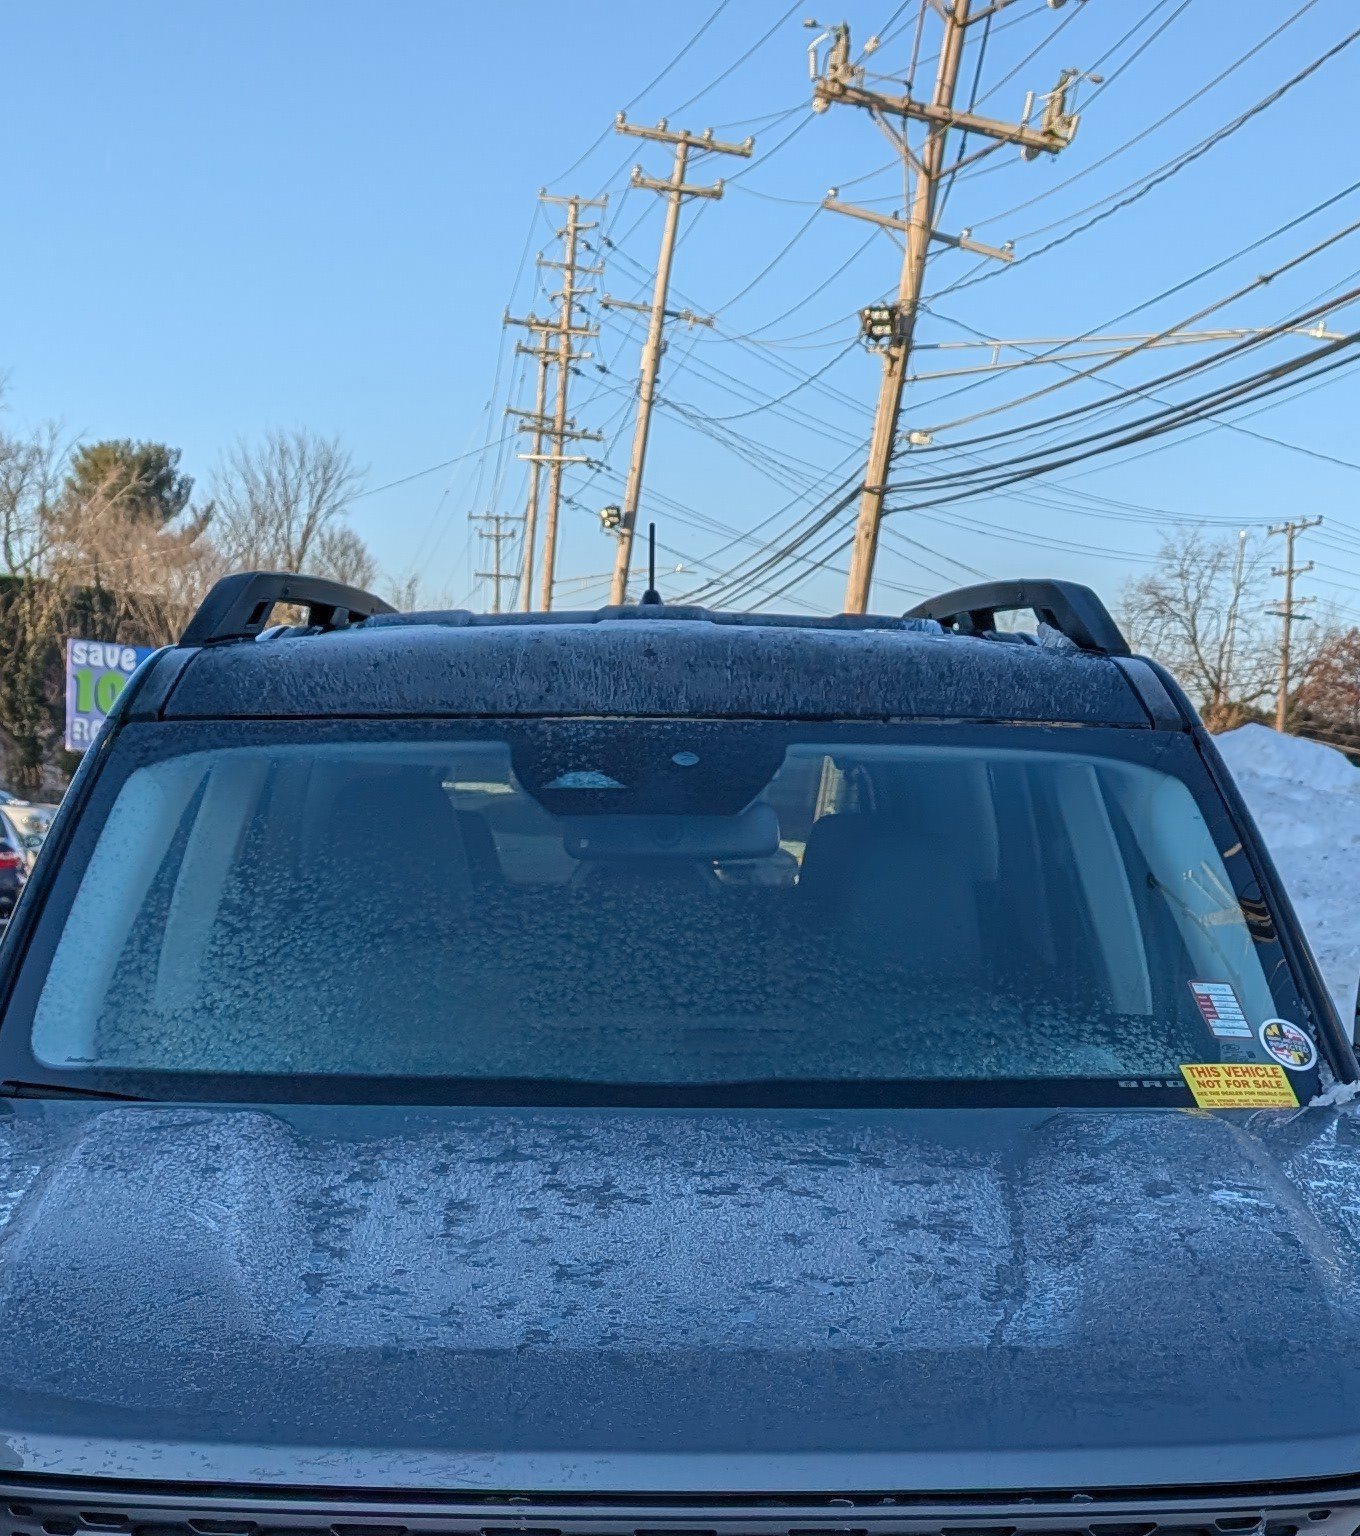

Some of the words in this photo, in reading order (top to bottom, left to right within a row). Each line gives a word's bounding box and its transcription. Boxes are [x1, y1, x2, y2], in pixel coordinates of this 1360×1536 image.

[71, 641, 137, 672] save
[1186, 1066, 1222, 1078] THIS
[1223, 1066, 1283, 1079] VEHICLE
[1117, 1080, 1186, 1088] BRO
[1196, 1079, 1223, 1089] NOT
[1225, 1079, 1252, 1089] FOR
[1253, 1079, 1284, 1090] SALE
